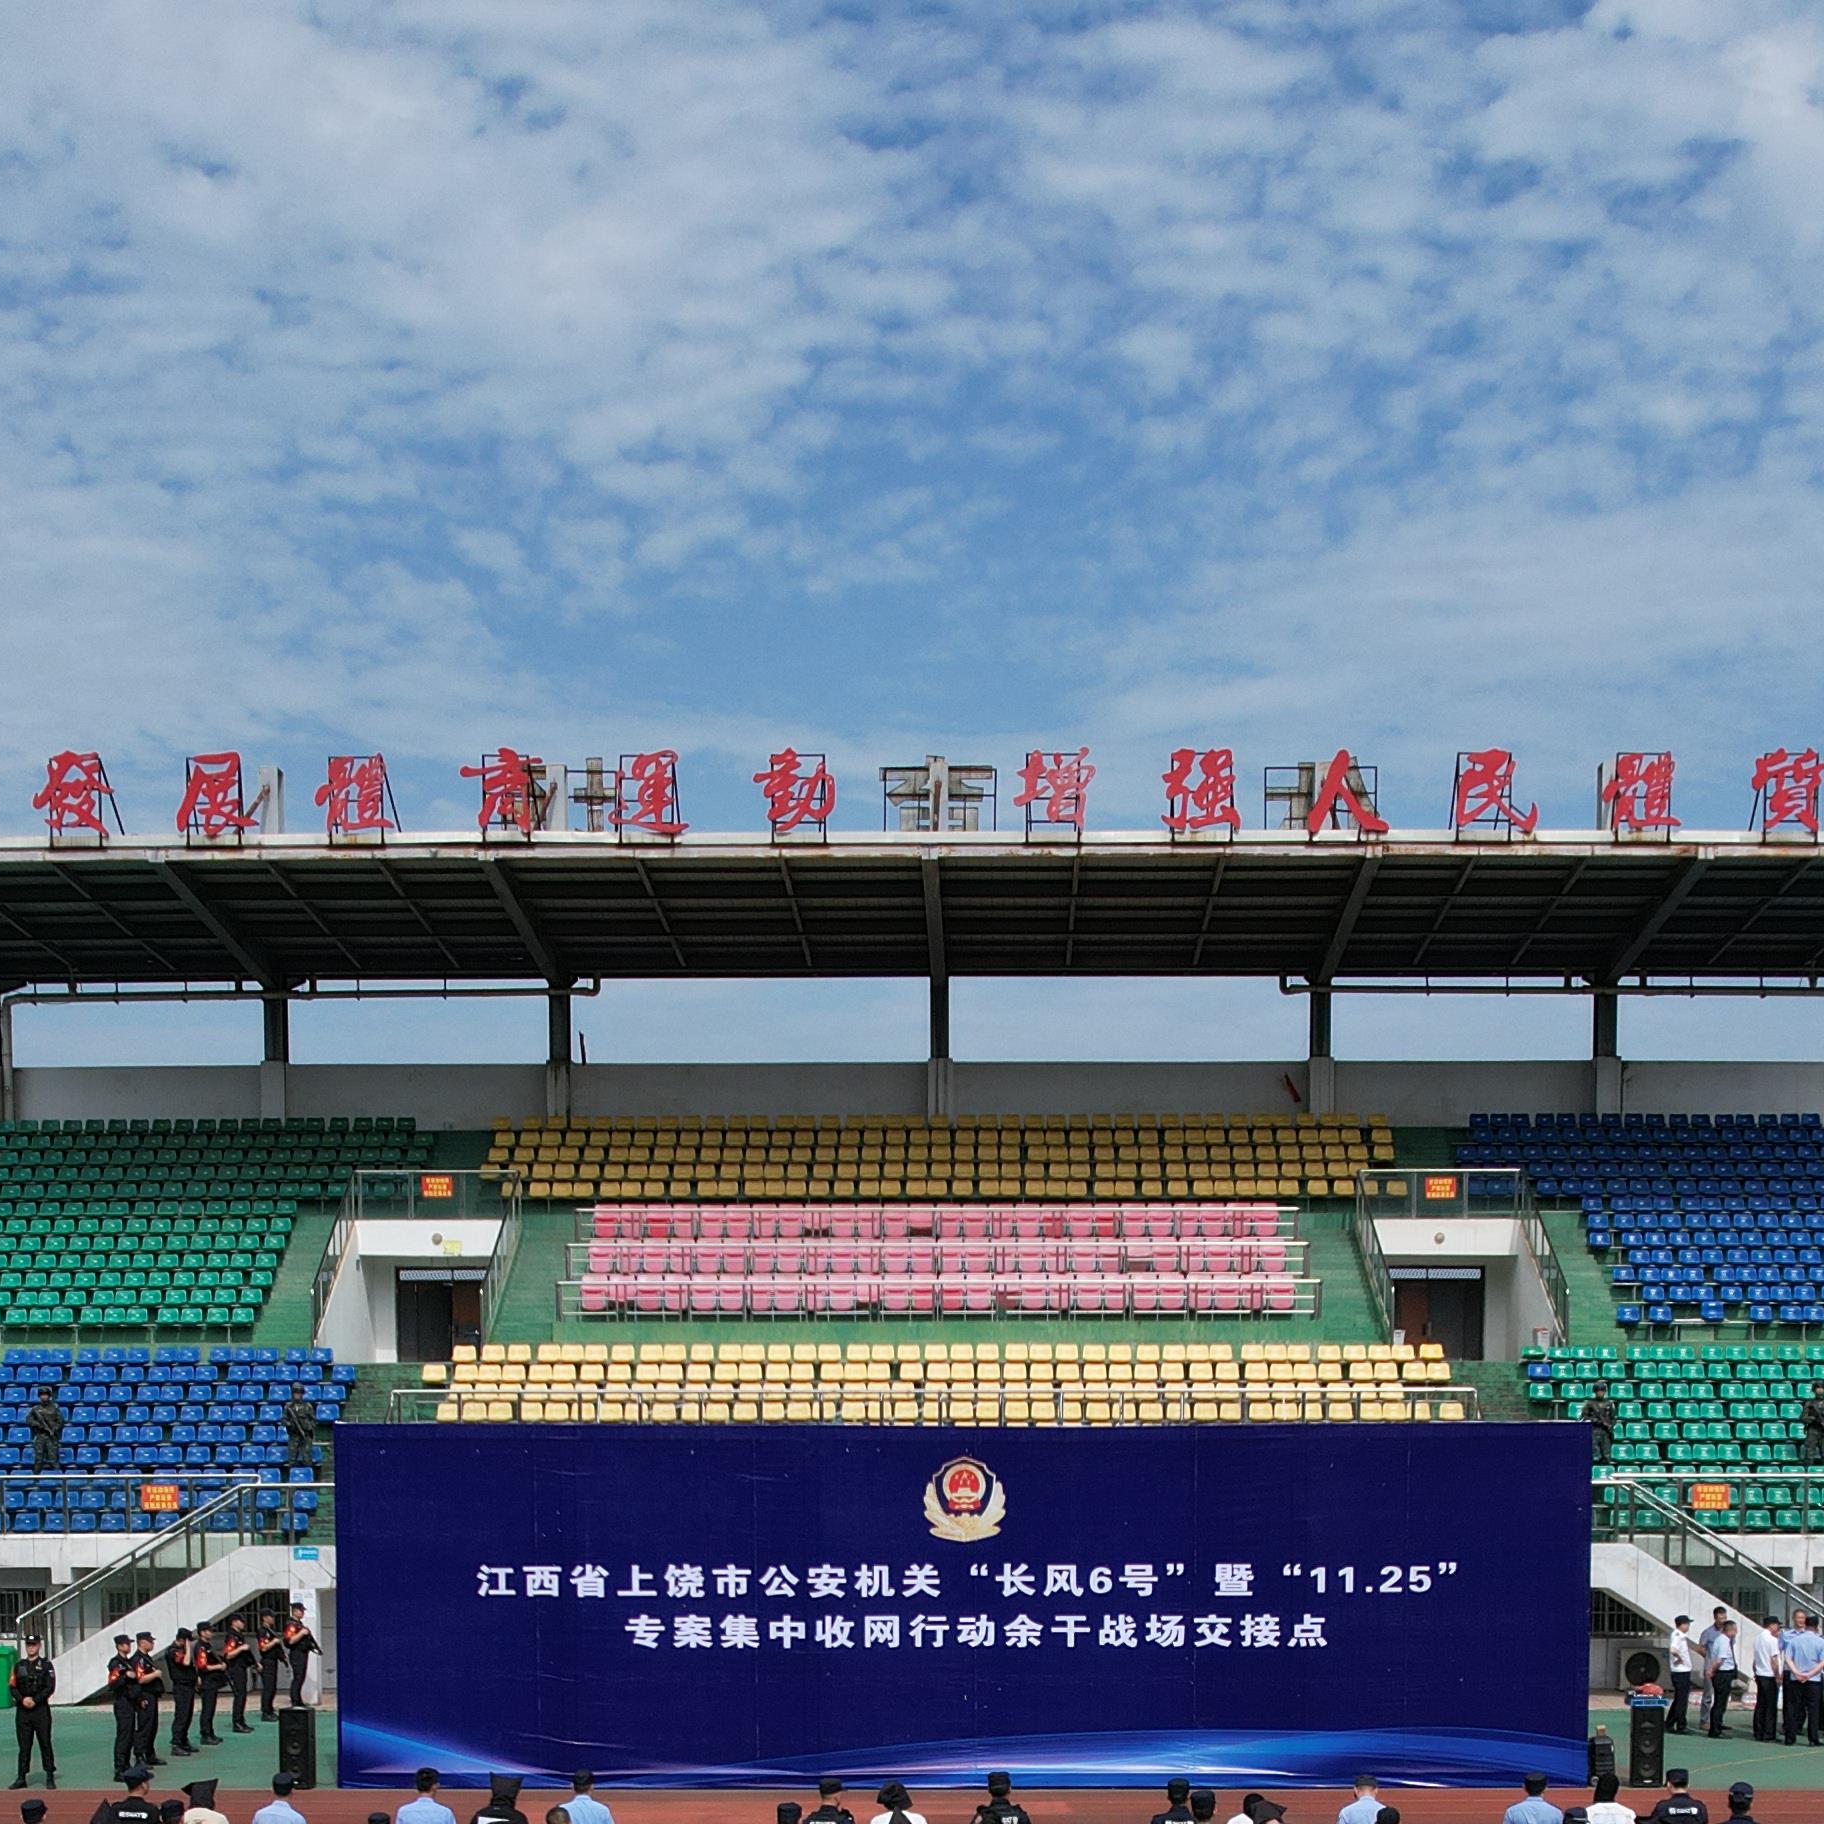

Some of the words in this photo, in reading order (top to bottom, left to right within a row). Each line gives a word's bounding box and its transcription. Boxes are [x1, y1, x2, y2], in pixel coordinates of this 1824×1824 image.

[625, 1613, 1328, 1650] 专案集中收网行动余干战场交接点
